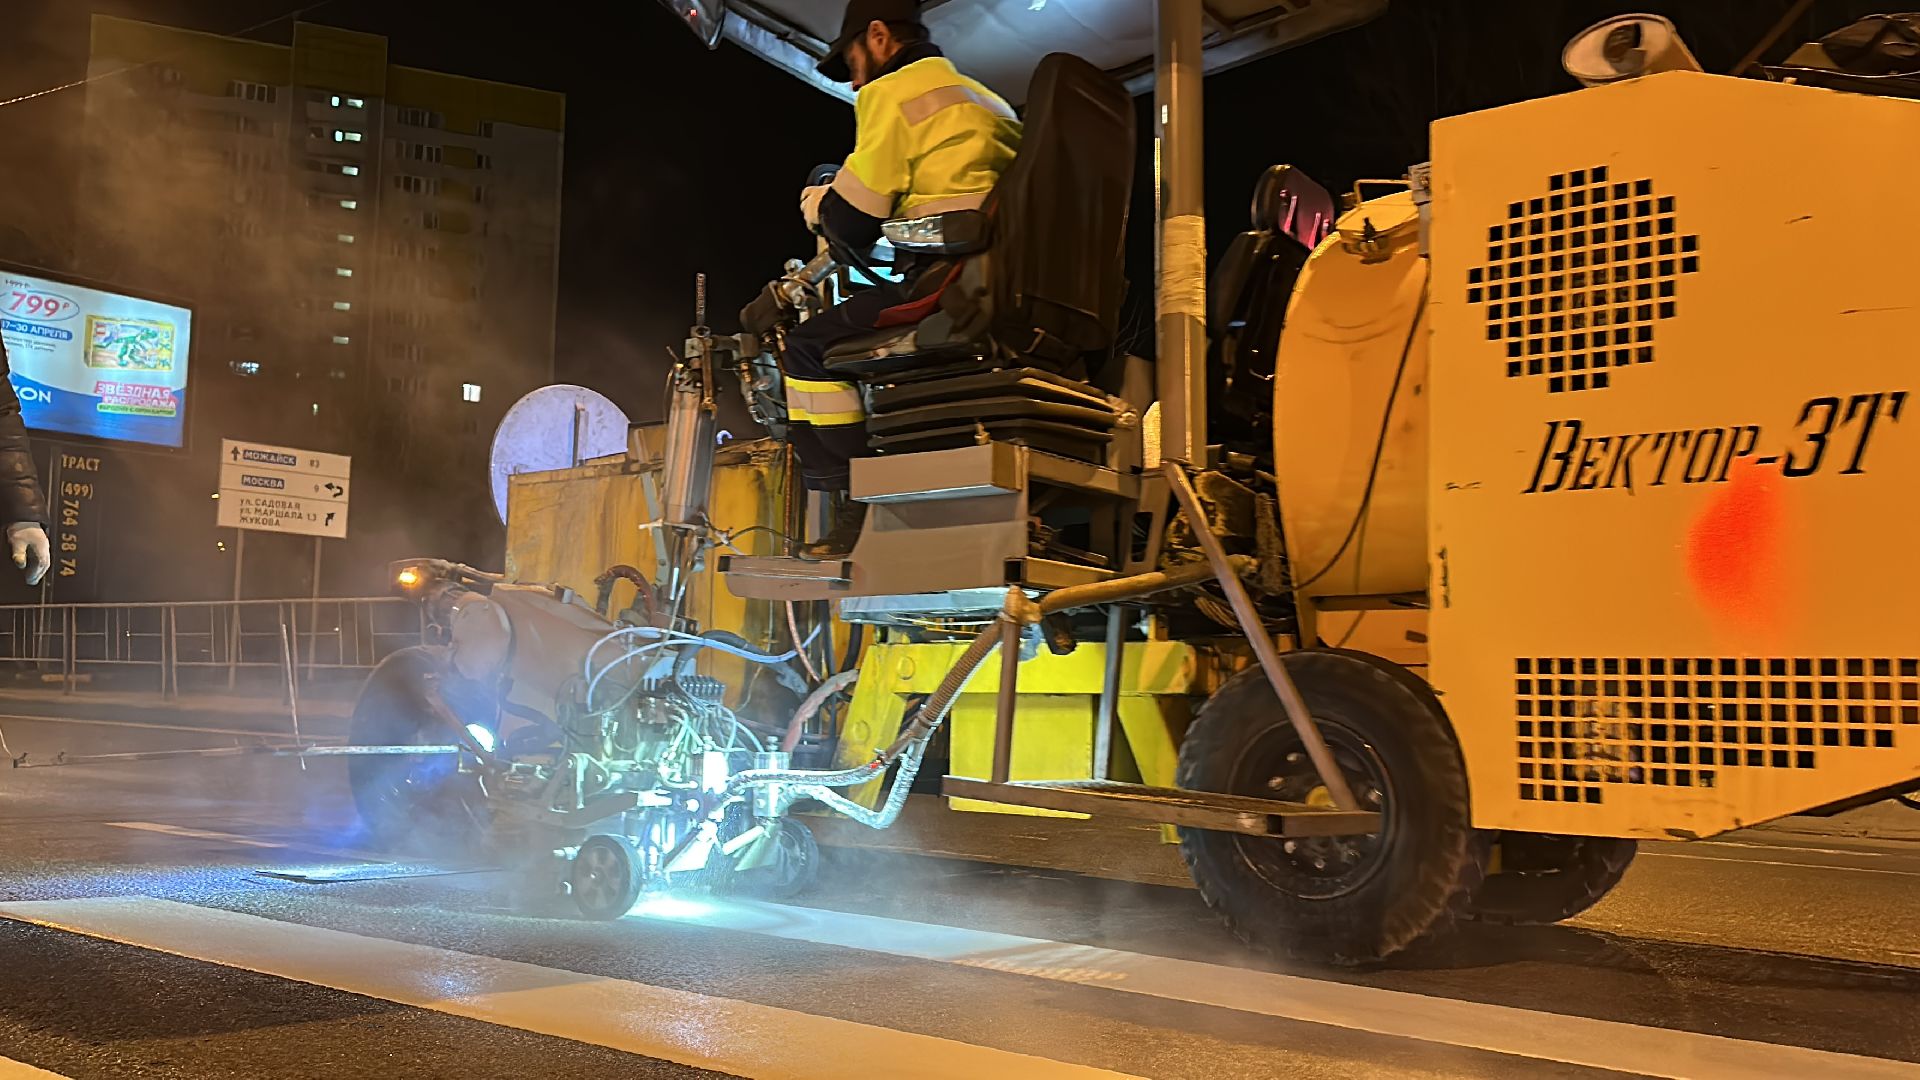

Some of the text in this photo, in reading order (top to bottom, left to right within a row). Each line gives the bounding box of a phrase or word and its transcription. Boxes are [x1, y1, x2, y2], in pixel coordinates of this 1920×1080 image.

[9, 290, 60, 318] 799
[30, 325, 69, 340] АПРЕЛЯ
[61, 454, 101, 472] ТРАСТ
[243, 449, 297, 466] МОЖАЙСК
[242, 475, 284, 489] МОСКВА
[255, 499, 301, 510] САДОВАЯ
[255, 507, 303, 519] МАРШАЛА
[60, 481, 94, 577] (499) 764 58 74
[240, 517, 280, 526] ЖУКОВА
